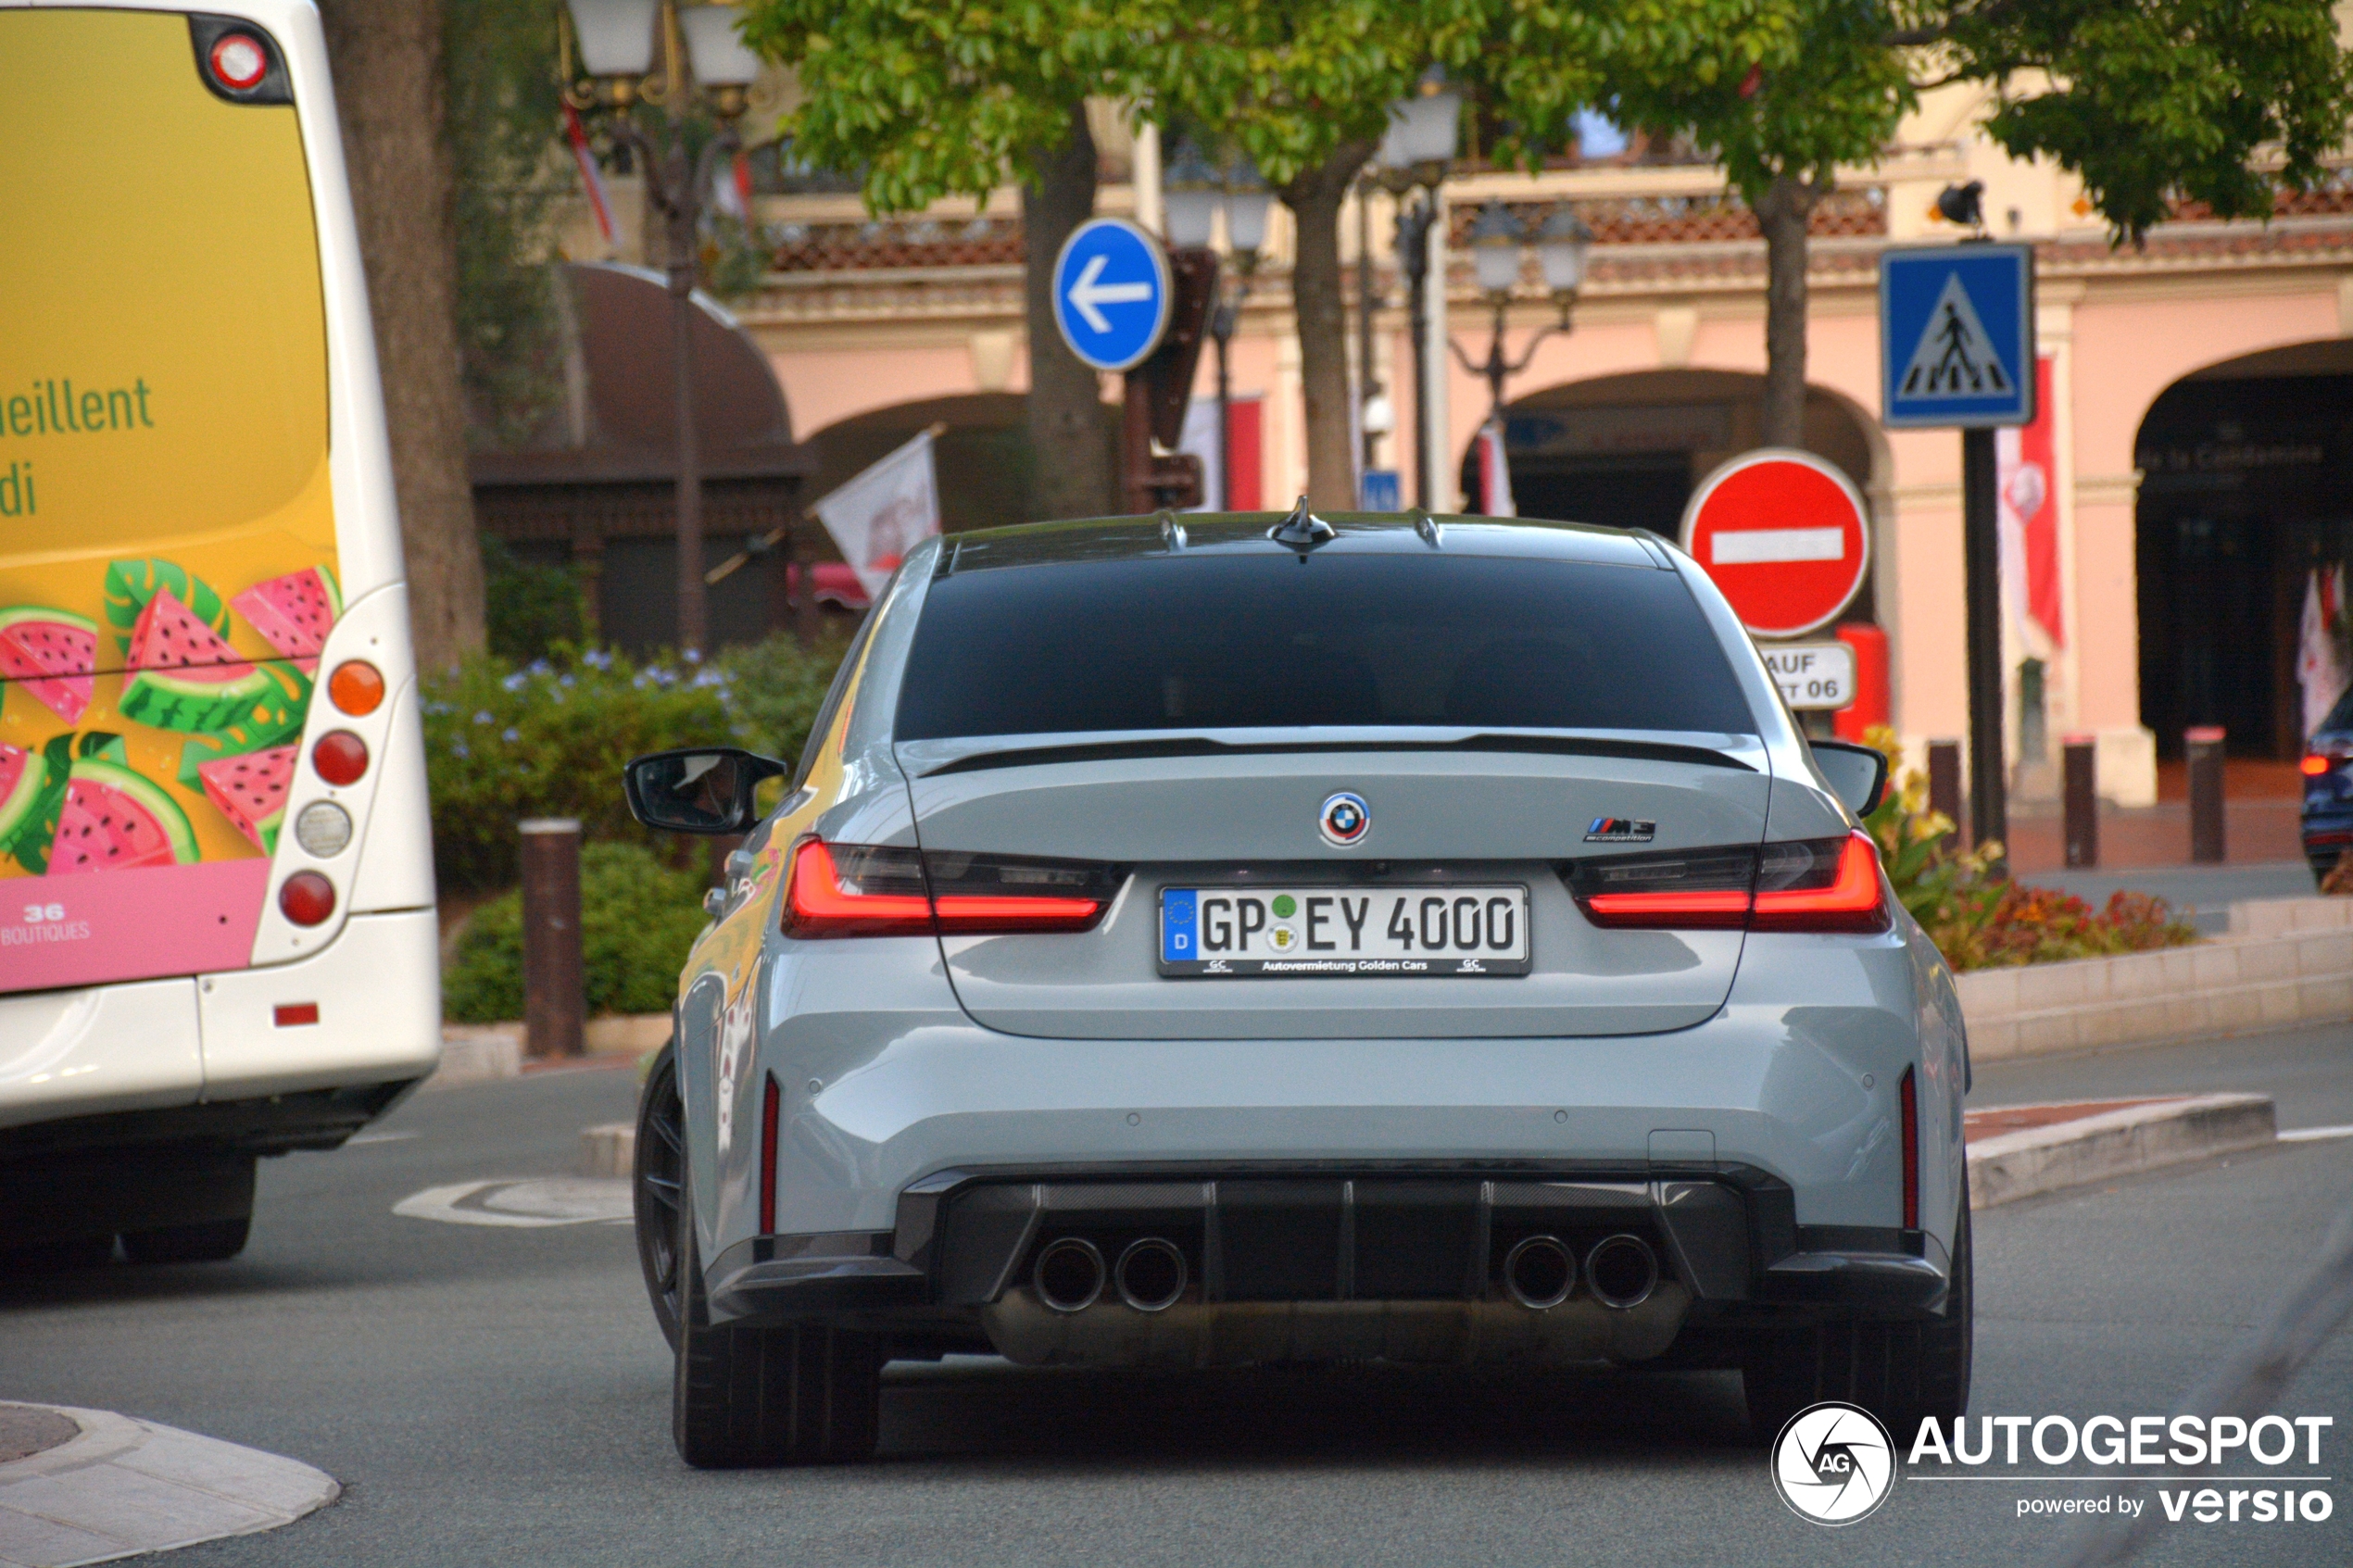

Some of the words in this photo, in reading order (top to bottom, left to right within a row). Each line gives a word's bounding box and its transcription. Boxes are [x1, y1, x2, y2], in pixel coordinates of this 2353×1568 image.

[1767, 655, 1816, 673] AUF
[1807, 680, 1838, 698] 06
[23, 903, 65, 923] 36
[1202, 897, 1265, 951] GP
[1306, 897, 1369, 950] EY
[1387, 897, 1515, 951] 4000
[1, 921, 91, 946] BOUTIQUES
[1175, 934, 1189, 950] D
[1209, 960, 1227, 969] GC
[1262, 960, 1356, 972] Autovermietung
[1358, 960, 1400, 971] Golden
[1402, 960, 1428, 971] Cars
[1463, 959, 1479, 968] GC
